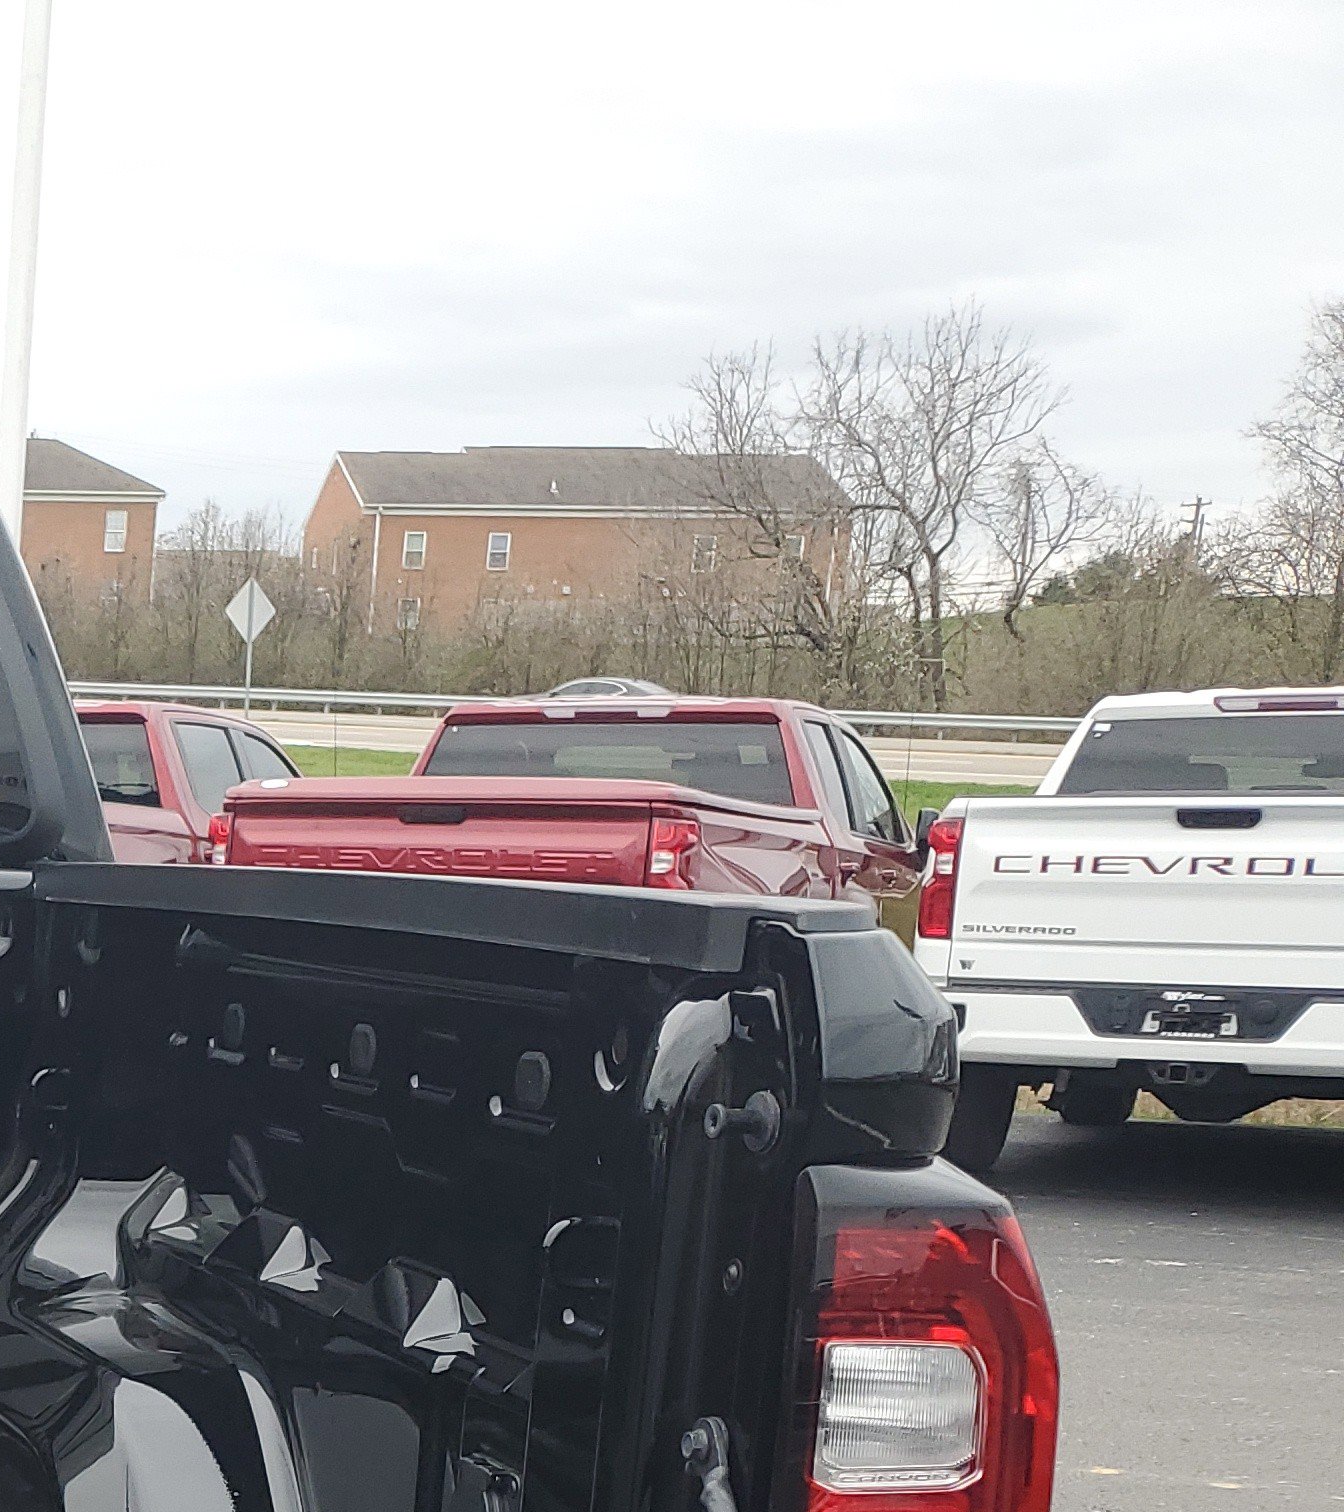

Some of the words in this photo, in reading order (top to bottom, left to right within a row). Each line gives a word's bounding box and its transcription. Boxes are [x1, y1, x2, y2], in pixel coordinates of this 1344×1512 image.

[255, 846, 615, 873] CHEVROLET
[962, 924, 1077, 935] SILVERADO
[839, 1473, 950, 1483] CANYON
